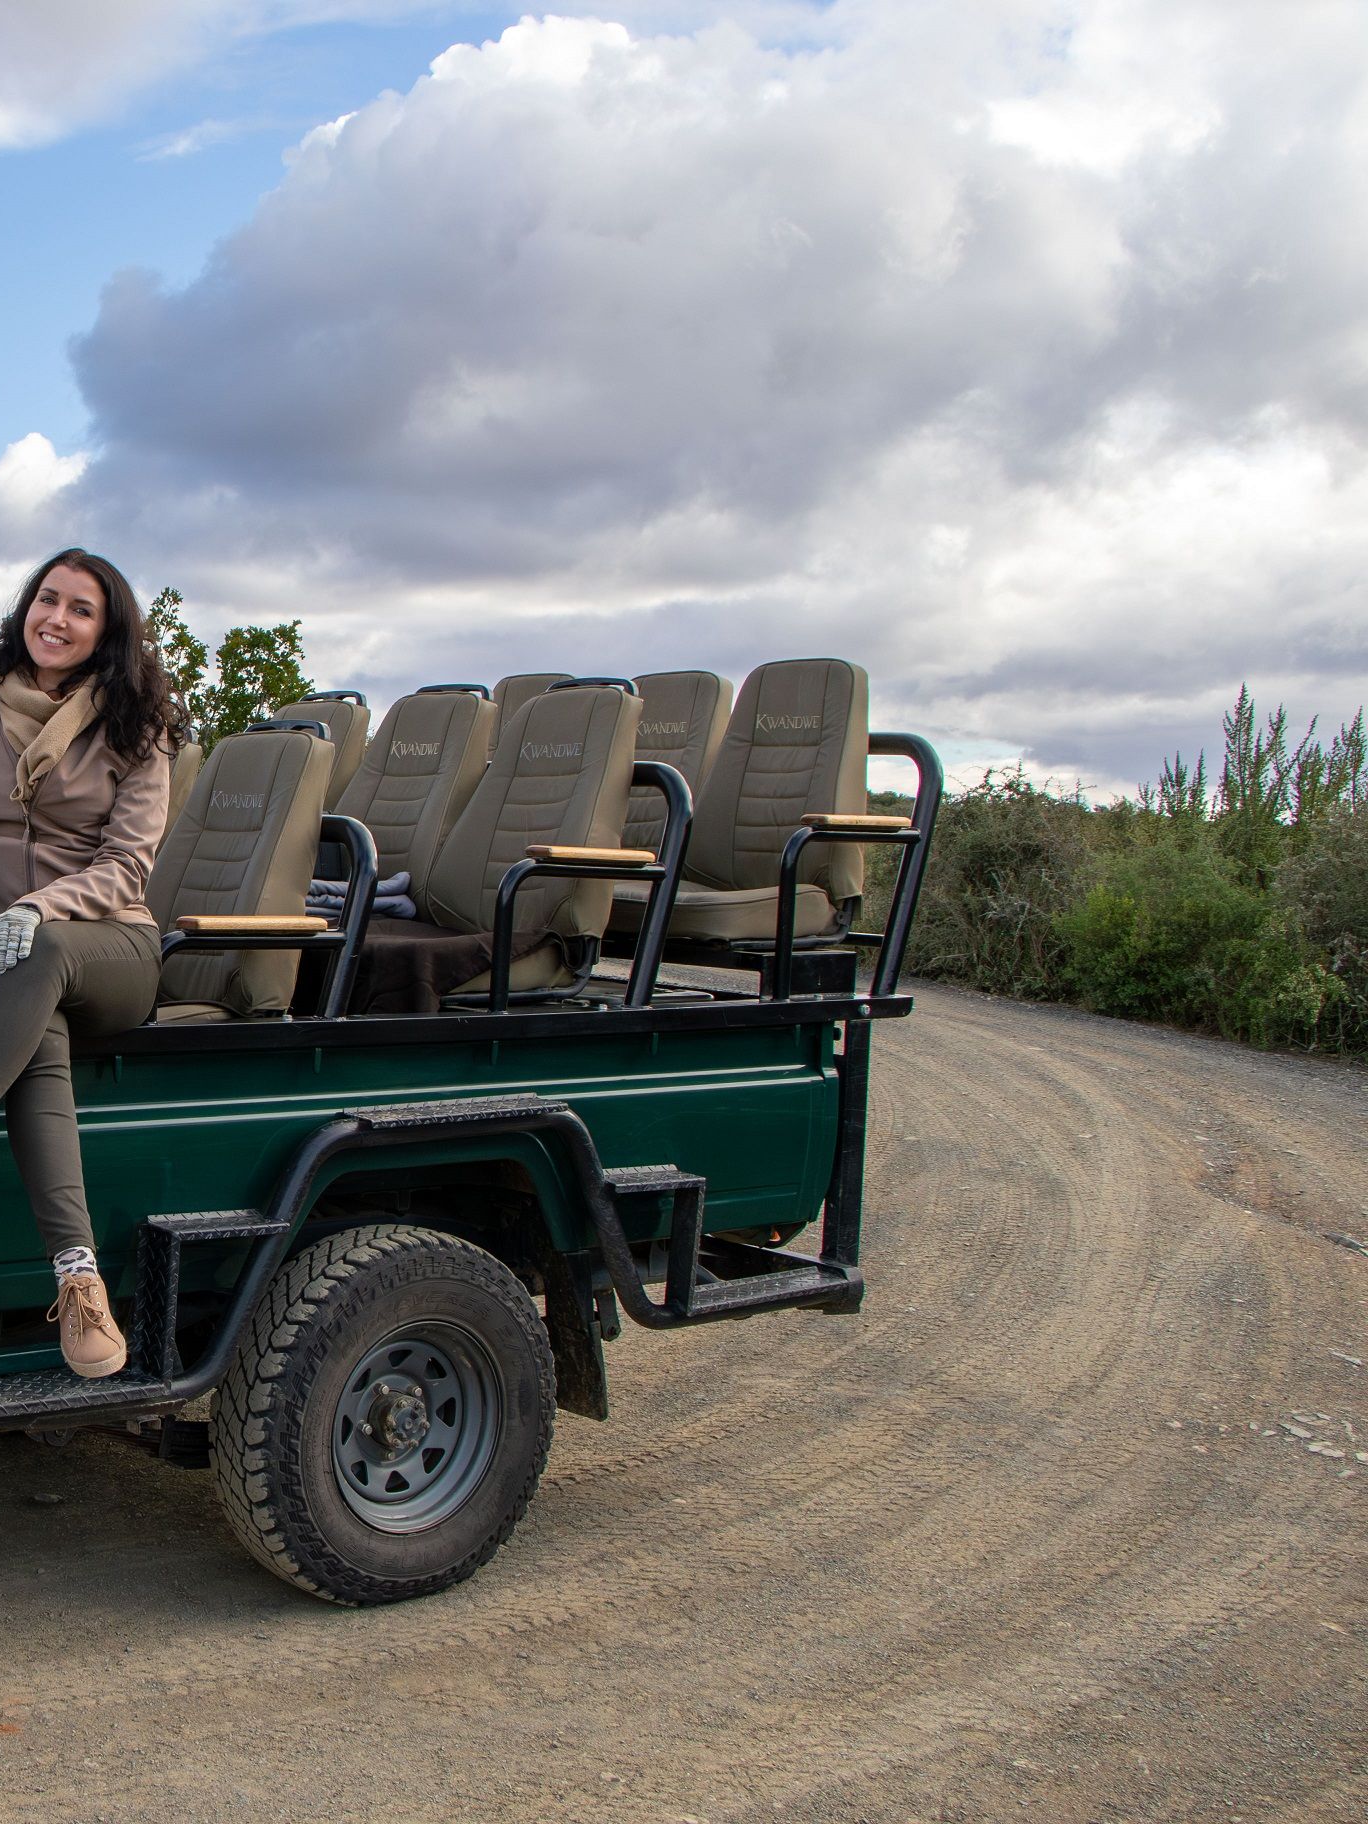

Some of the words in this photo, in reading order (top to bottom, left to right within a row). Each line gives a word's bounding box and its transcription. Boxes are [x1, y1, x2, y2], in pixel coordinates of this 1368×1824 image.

[756, 713, 821, 733] KWANDWE
[390, 740, 440, 760] KWANDWE
[519, 741, 583, 761] KWANDWE
[209, 790, 265, 816] KWANDWE
